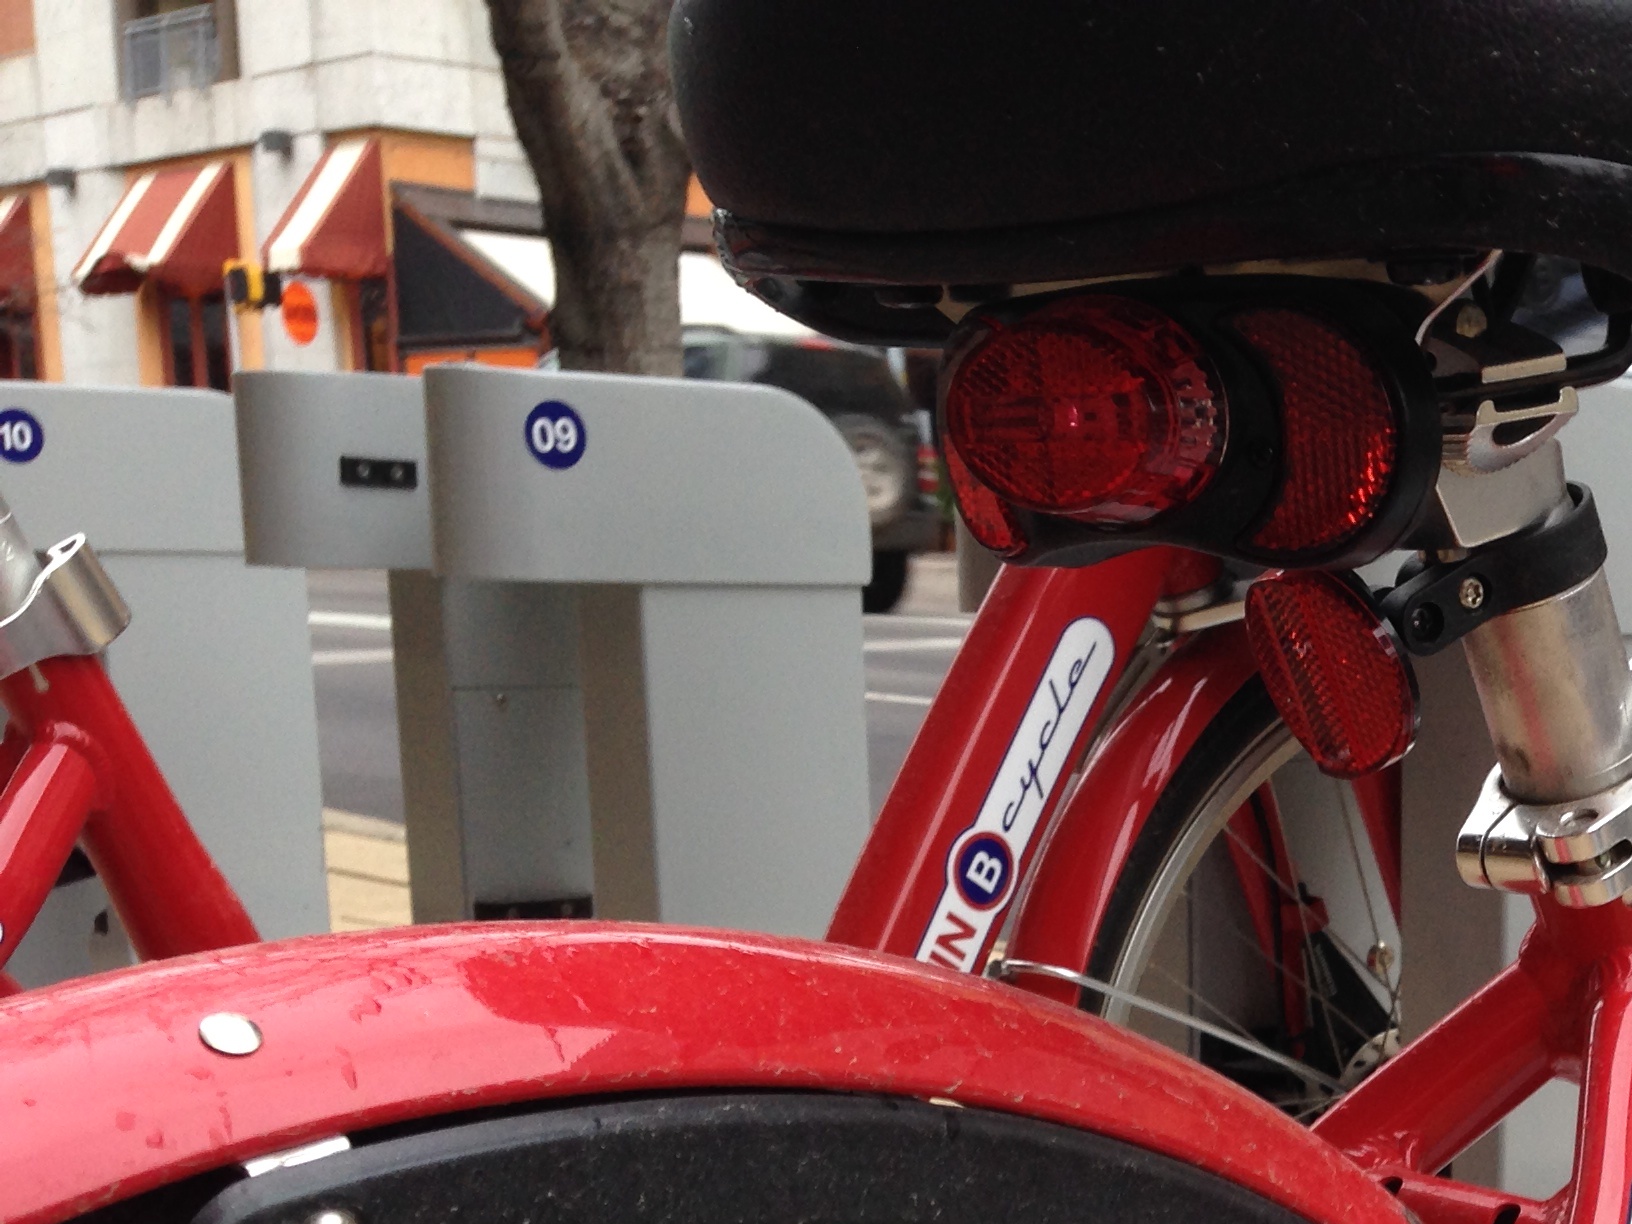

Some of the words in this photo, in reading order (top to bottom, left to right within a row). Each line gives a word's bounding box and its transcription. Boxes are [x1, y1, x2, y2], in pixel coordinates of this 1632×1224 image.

[0, 420, 33, 452] 10
[531, 416, 578, 454] 09
[965, 850, 1004, 895] B
[1002, 641, 1097, 833] cycle
